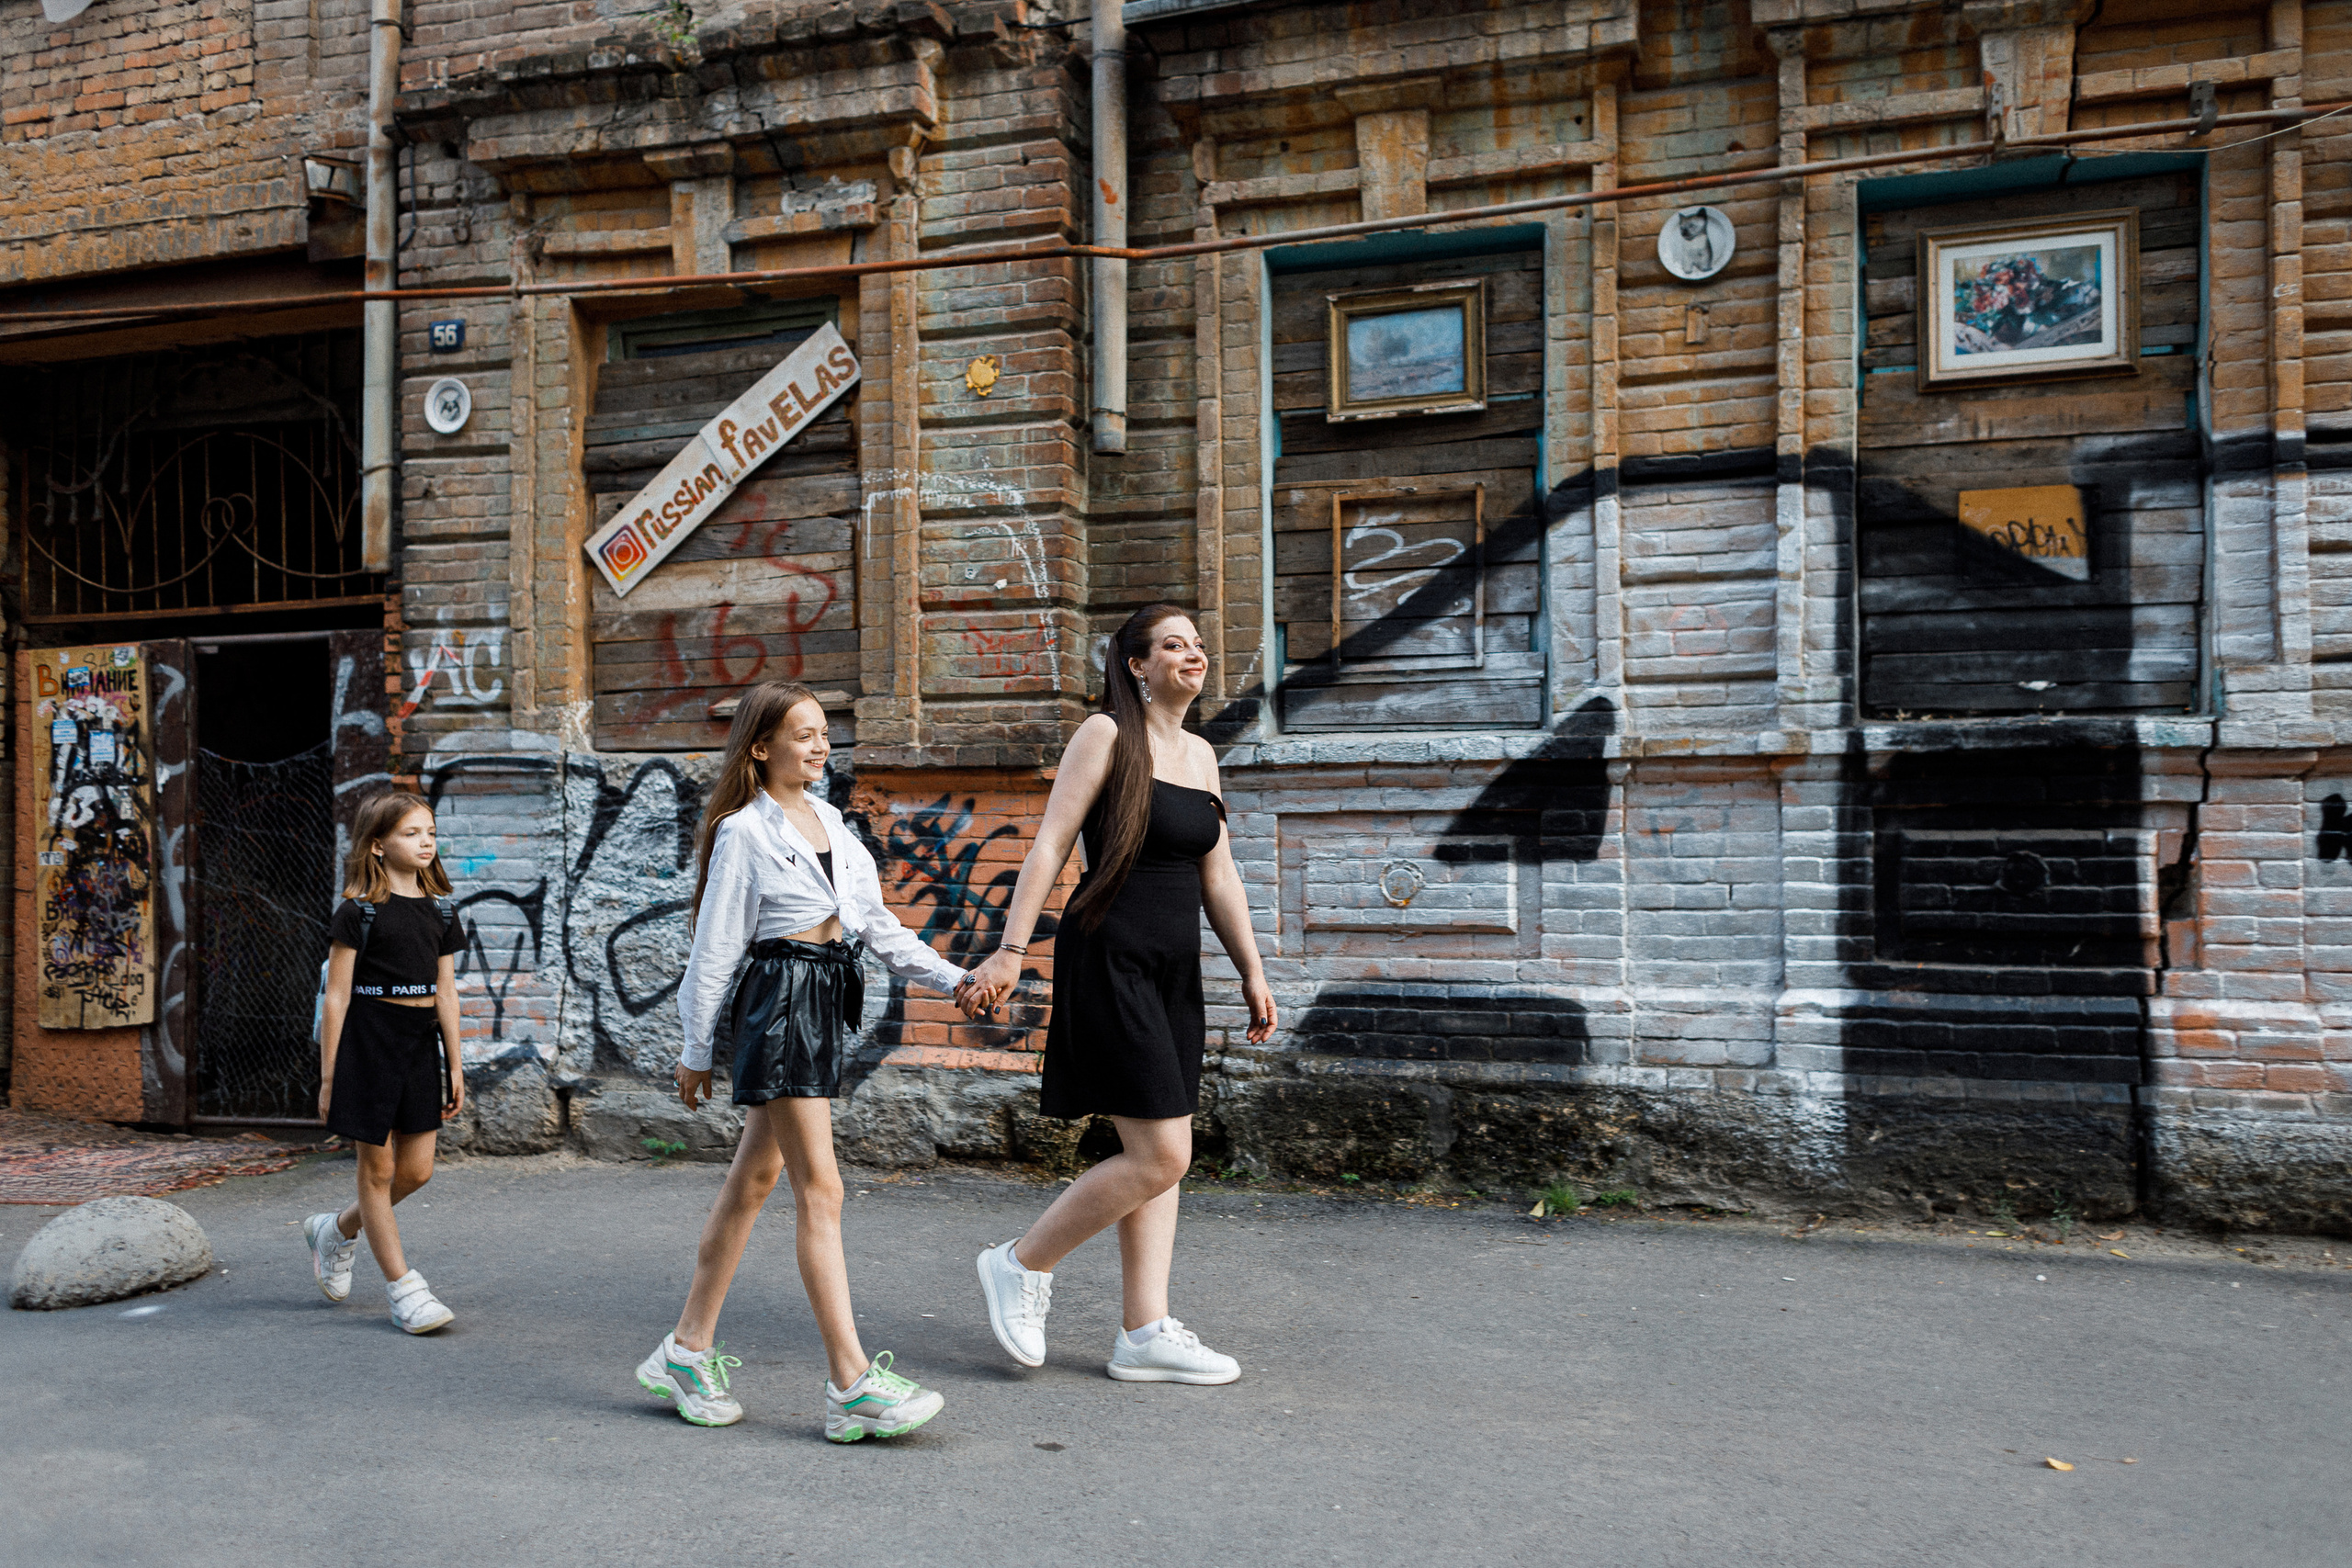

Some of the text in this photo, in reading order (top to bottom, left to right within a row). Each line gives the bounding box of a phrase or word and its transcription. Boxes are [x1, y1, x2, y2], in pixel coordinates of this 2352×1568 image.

[434, 324, 457, 346] 56
[38, 663, 139, 697] ВНАНИЕ
[391, 985, 427, 996] PARIS
